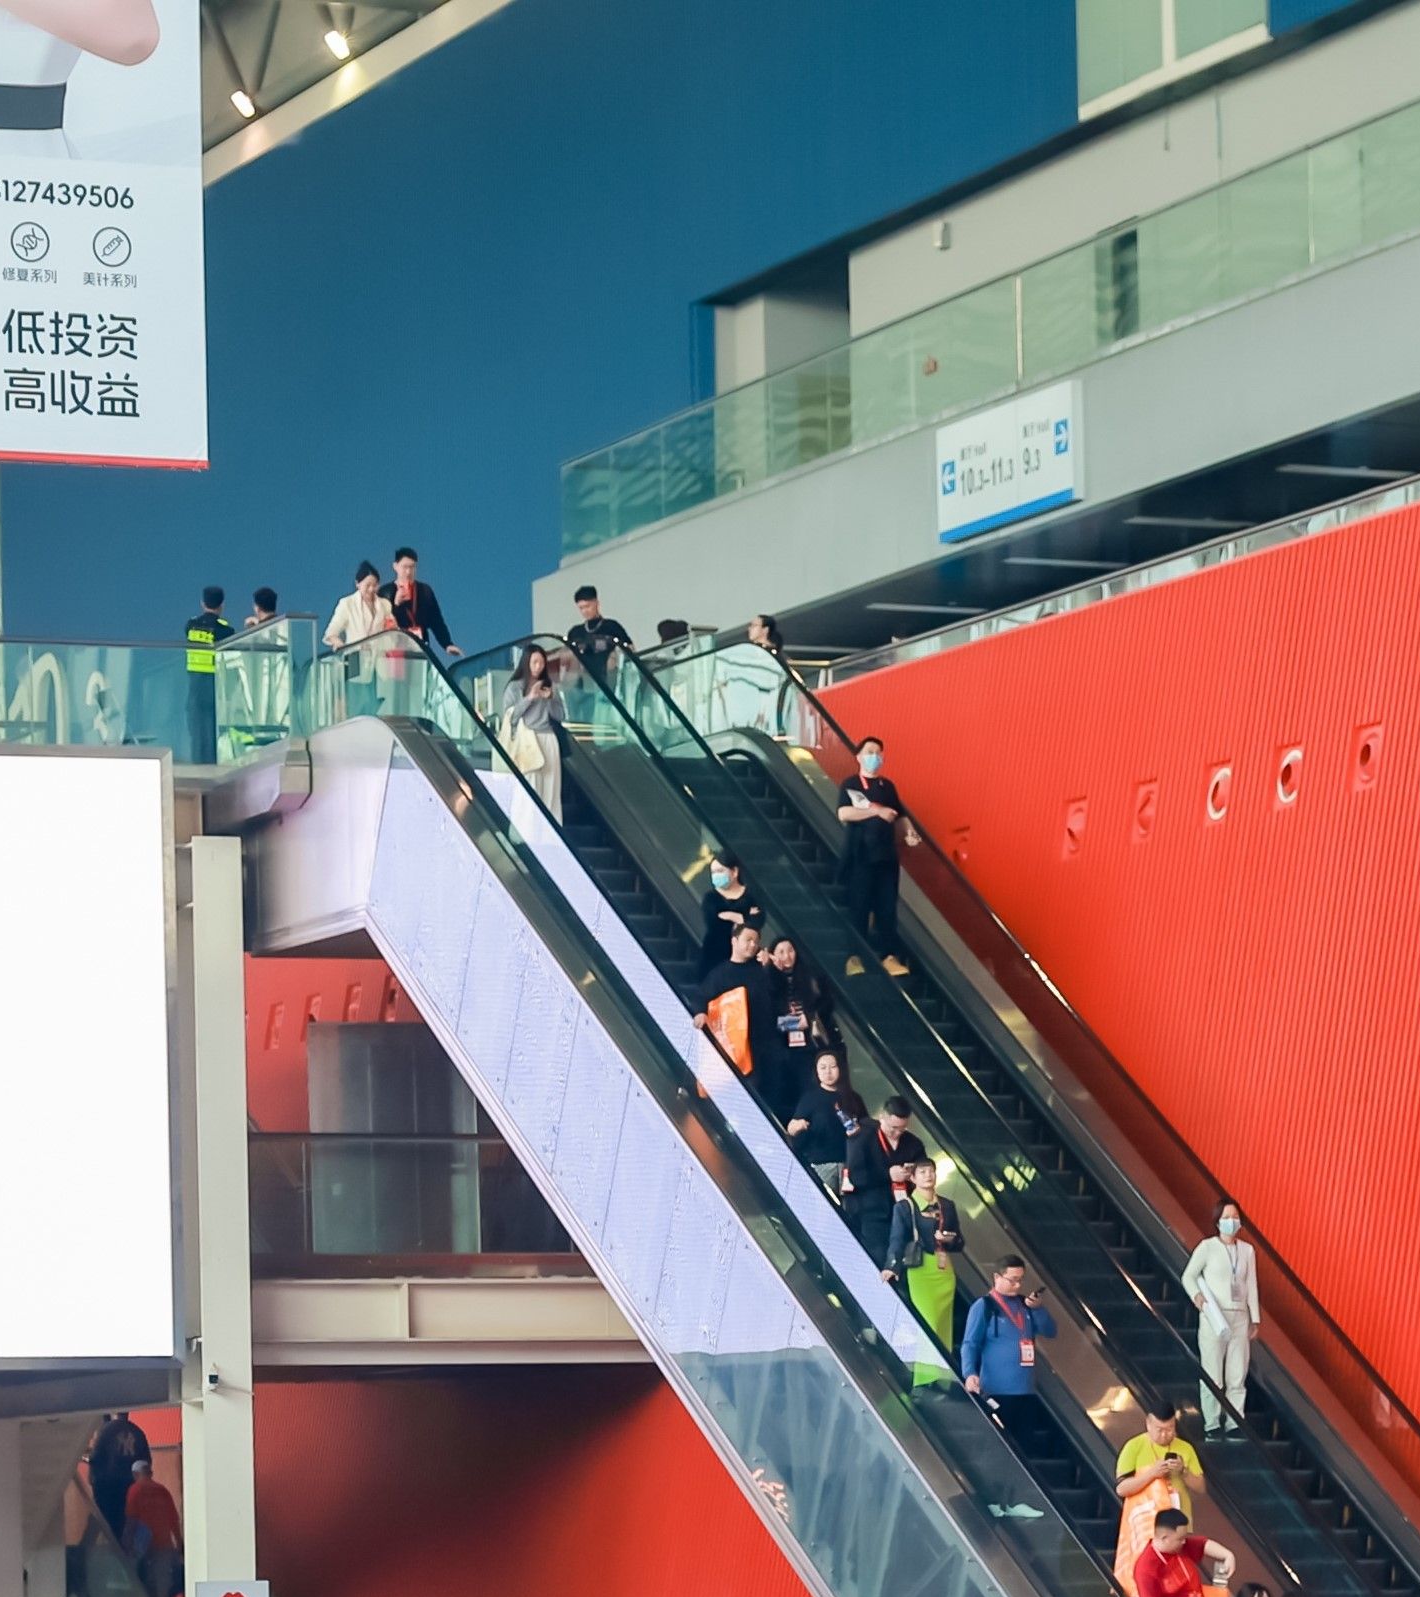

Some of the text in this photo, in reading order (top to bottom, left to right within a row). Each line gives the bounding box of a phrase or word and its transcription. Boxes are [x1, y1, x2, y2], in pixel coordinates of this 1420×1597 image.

[2, 308, 139, 360] 低投资
[3, 367, 141, 418] 高收益
